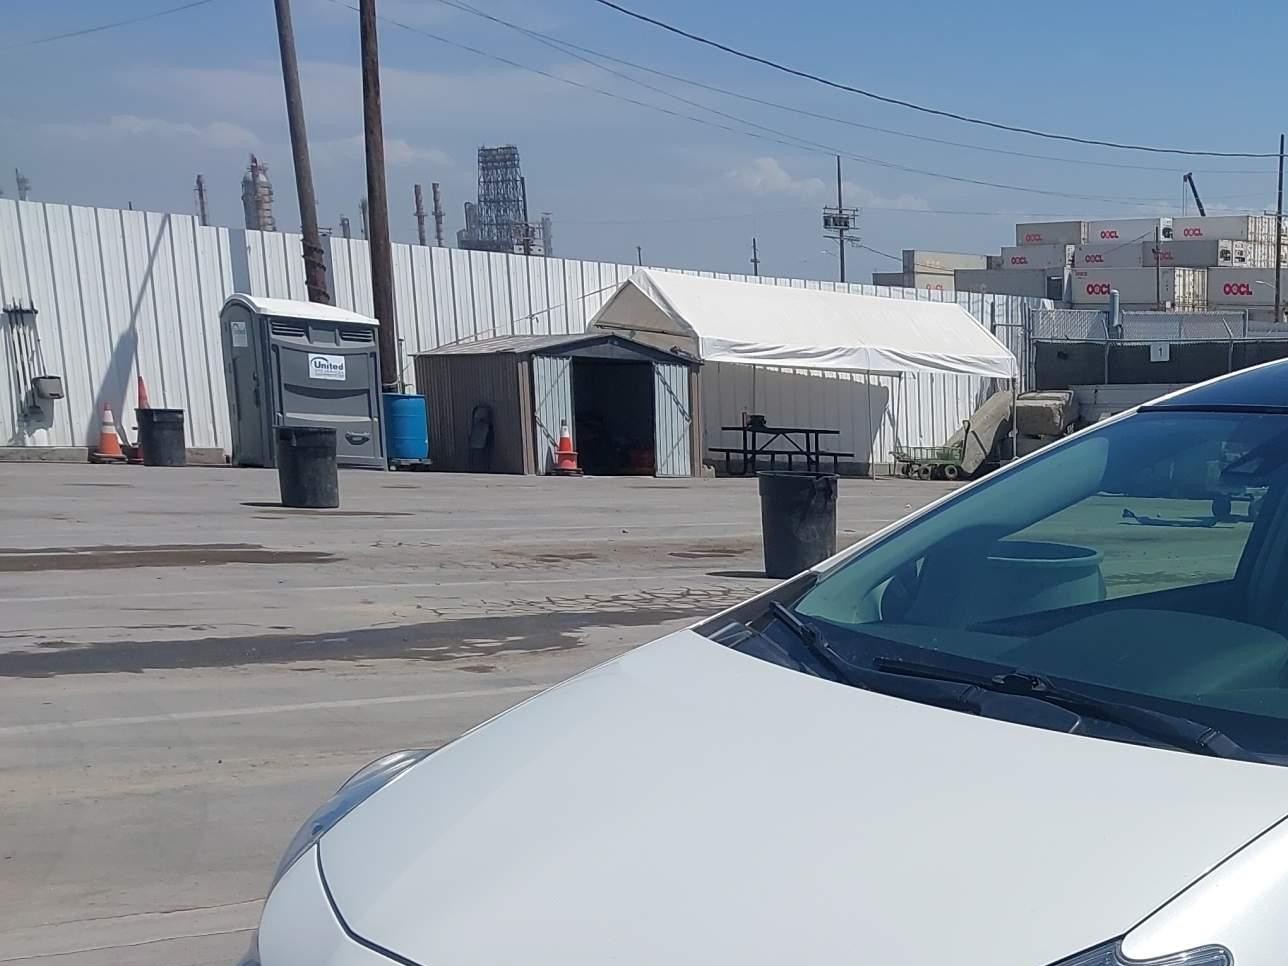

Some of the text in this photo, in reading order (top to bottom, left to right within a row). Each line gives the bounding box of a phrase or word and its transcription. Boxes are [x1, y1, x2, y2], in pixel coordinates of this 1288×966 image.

[1100, 230, 1119, 239] OOCL
[1183, 228, 1203, 237] OOCL
[1085, 254, 1104, 263] OOCL
[1154, 251, 1174, 260] OCL
[1011, 256, 1028, 265] OOCL
[1223, 283, 1253, 296] OOCL
[314, 361, 344, 370] United
